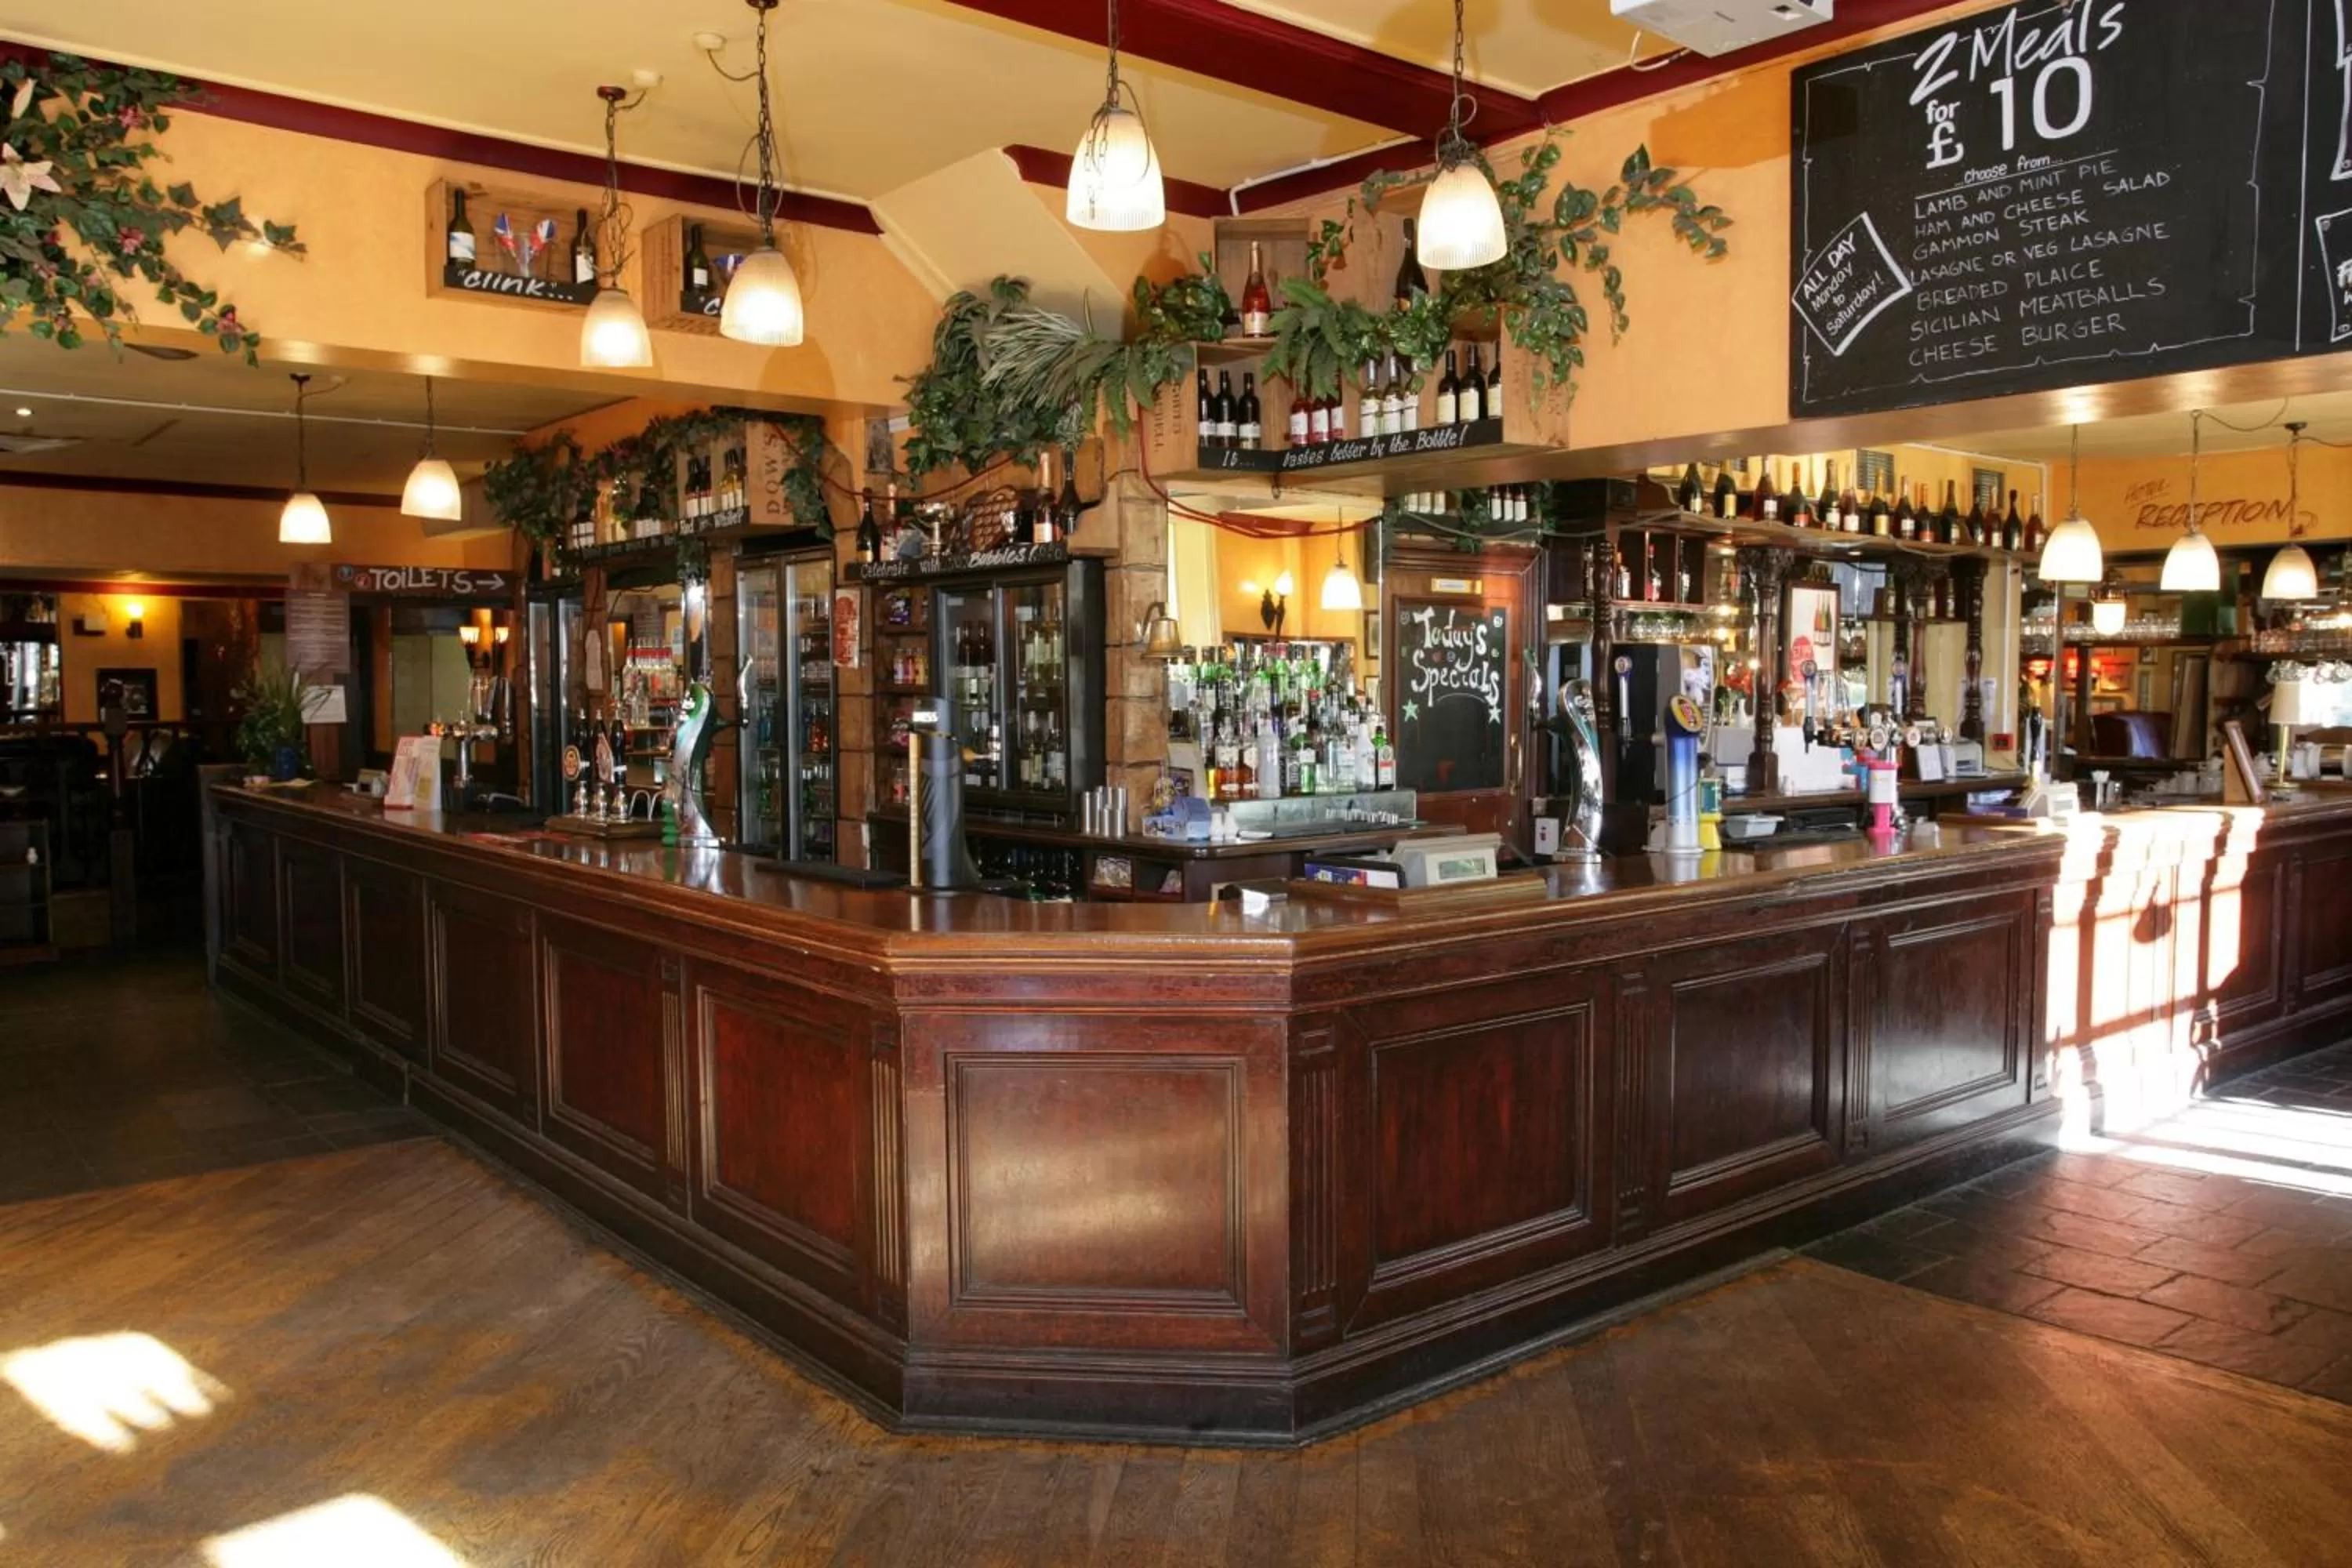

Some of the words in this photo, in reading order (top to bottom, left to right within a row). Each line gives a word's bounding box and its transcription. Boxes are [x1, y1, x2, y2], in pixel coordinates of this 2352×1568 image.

[1909, 31, 1958, 106] 2
[1969, 2, 2125, 82] Meals
[1926, 99, 1961, 124] for
[1926, 120, 1964, 169] £
[1990, 56, 2092, 151] 10
[1915, 196, 1969, 220] LAMB
[1977, 184, 2013, 203] AND
[2019, 169, 2067, 194] MINT
[2078, 159, 2118, 180] PIE
[1915, 219, 1951, 239] HAM
[1961, 212, 1996, 230] AND
[2003, 189, 2085, 220] CHEESE
[2103, 172, 2171, 196] SALAD
[1803, 270, 1828, 300] ALL
[1828, 231, 1856, 269] DAY
[1910, 256, 1986, 288] LASAGNE
[1991, 251, 2017, 268] OR
[2023, 243, 2059, 260] VEG
[2070, 222, 2171, 252] LASAGNE
[1912, 227, 2000, 262] GAMMON
[2019, 209, 2091, 238] STEAK
[1810, 261, 1853, 313] Monday
[1825, 270, 1883, 336] Saturday!
[1832, 293, 1846, 307] to
[1909, 307, 2002, 343] SICILIAN
[2019, 277, 2167, 318] MEATBALLS
[1915, 280, 2009, 312] BREADED
[2024, 258, 2105, 290] PLAICE
[1908, 335, 1999, 367] CHEESE
[2021, 313, 2127, 347] BURGER
[1414, 605, 1487, 672] Today's
[1410, 648, 1500, 707] Specials
